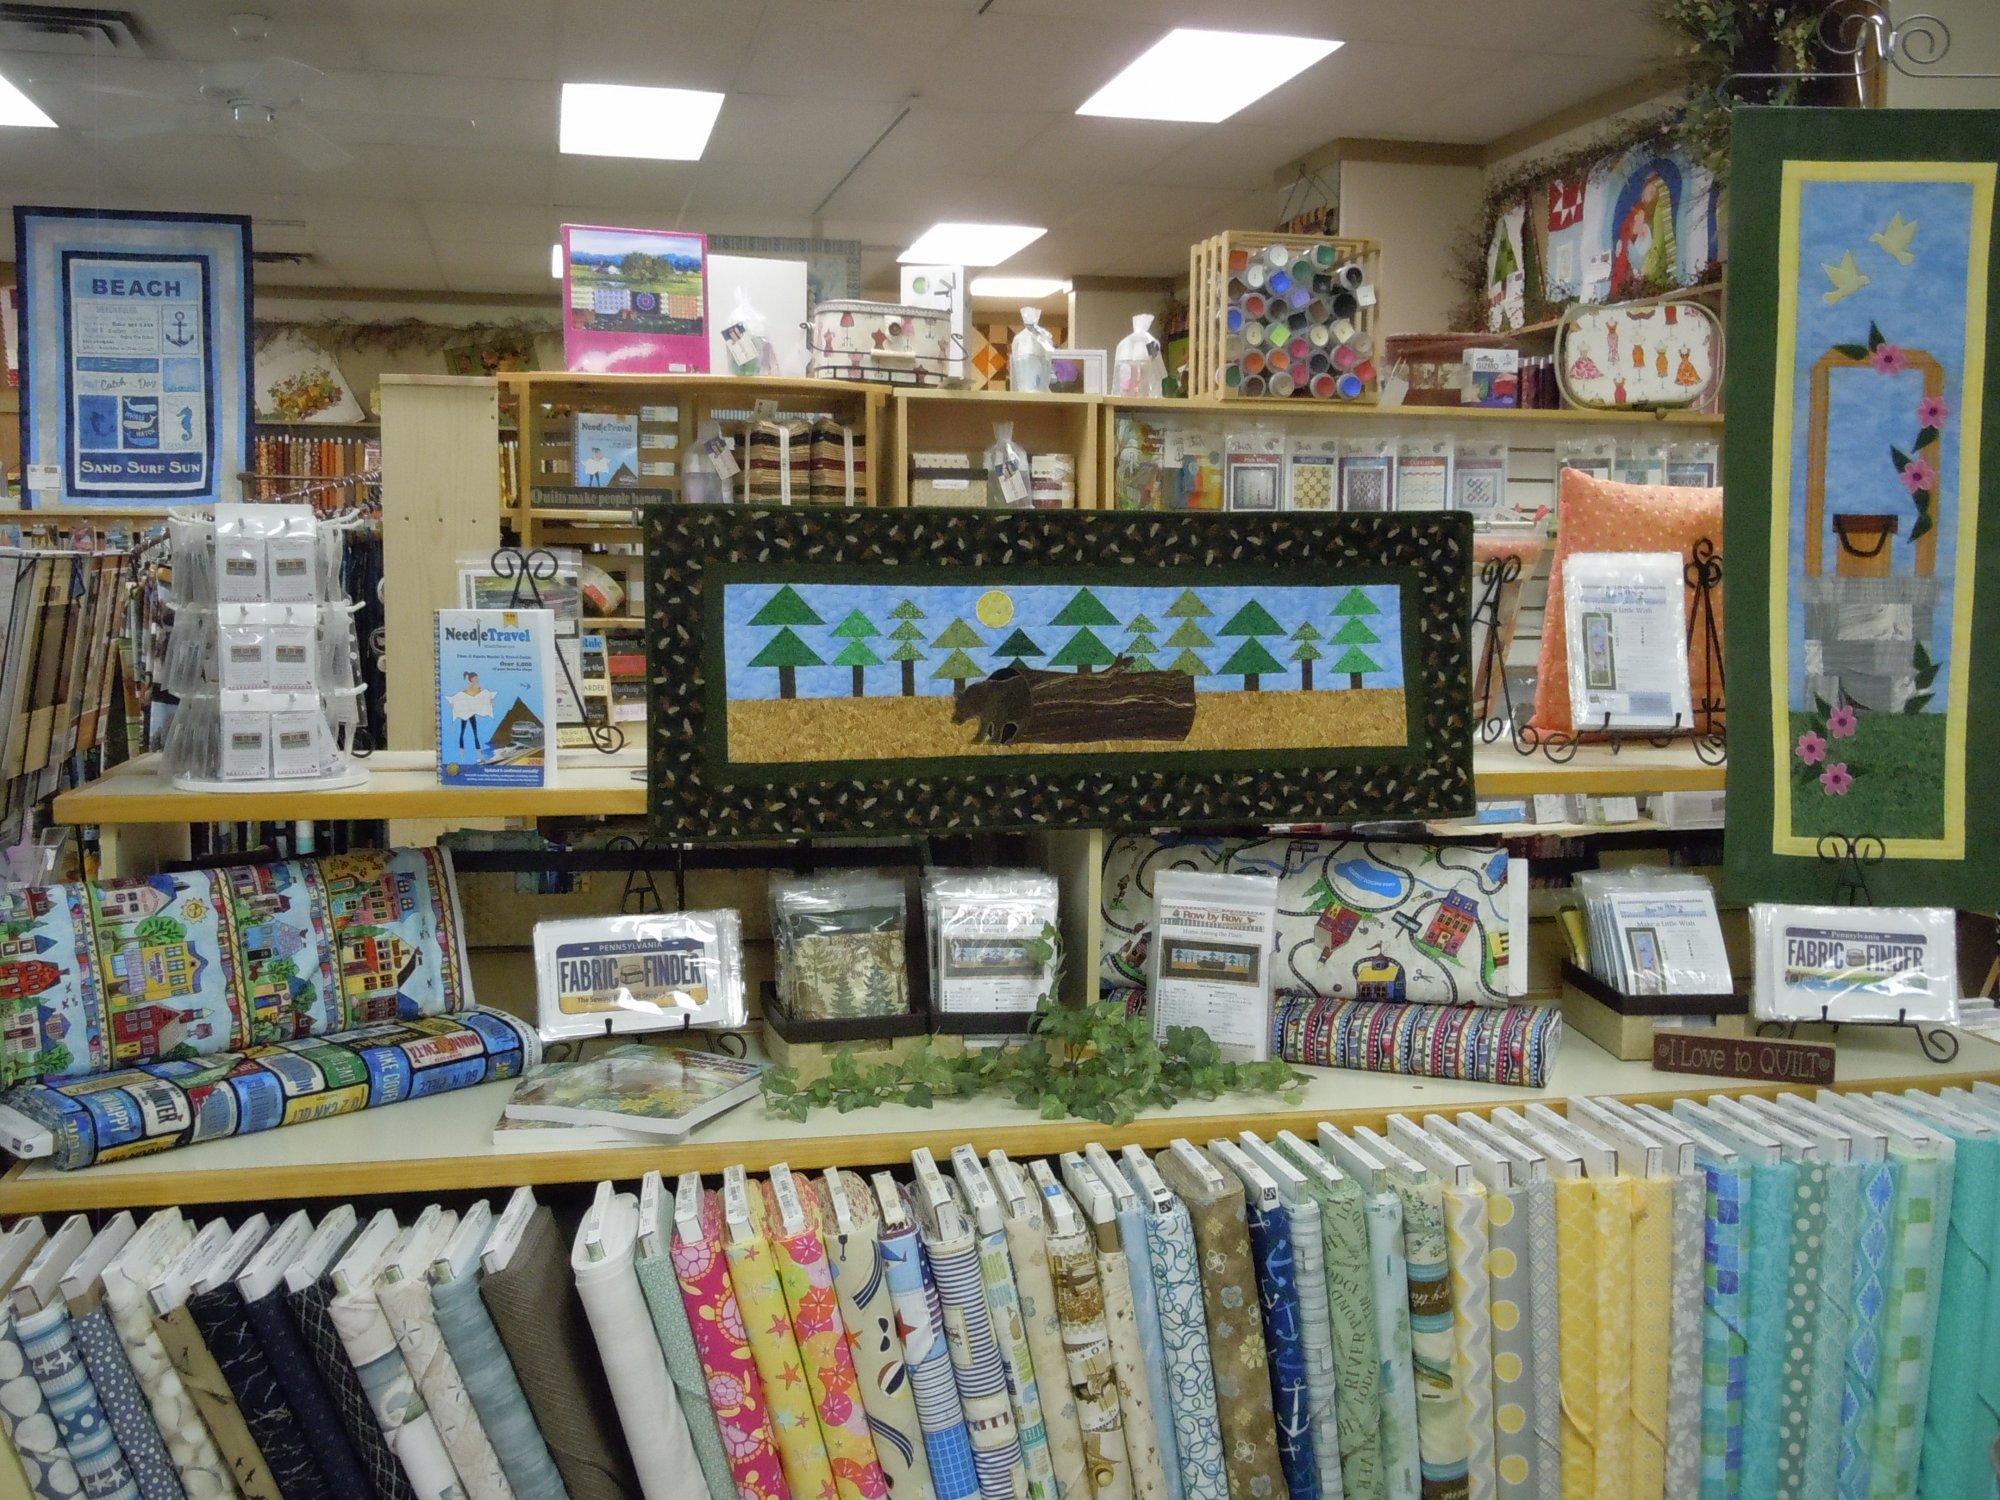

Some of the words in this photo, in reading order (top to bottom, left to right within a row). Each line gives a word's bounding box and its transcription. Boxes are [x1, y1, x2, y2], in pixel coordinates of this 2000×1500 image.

[92, 279, 181, 297] BEACH
[1476, 362, 1499, 370] GIZMO
[101, 377, 126, 391] Catch
[138, 378, 157, 390] Day
[81, 461, 122, 474] SAND
[127, 461, 165, 474] SURF
[169, 461, 201, 474] SUN
[568, 491, 598, 504] make
[598, 491, 631, 508] people
[583, 683, 605, 692] ARDER
[1183, 909, 1205, 919] Row
[1207, 911, 1220, 922] by
[1221, 913, 1243, 923] Row
[1678, 919, 1696, 927] Wish
[1831, 930, 1880, 942] Pennsylvania
[599, 941, 662, 952] PENNSYLVANIA
[1787, 939, 1844, 969] FABRIC
[1866, 943, 1925, 972] FINDER
[560, 957, 619, 993] FABRIC
[643, 953, 701, 987] FINDER
[373, 1050, 399, 1072] TAKE
[1680, 1040, 1726, 1070] Love
[1734, 1047, 1751, 1072] to
[1759, 1046, 1820, 1079] QUILT
[1343, 1332, 1367, 1390] RIVER
